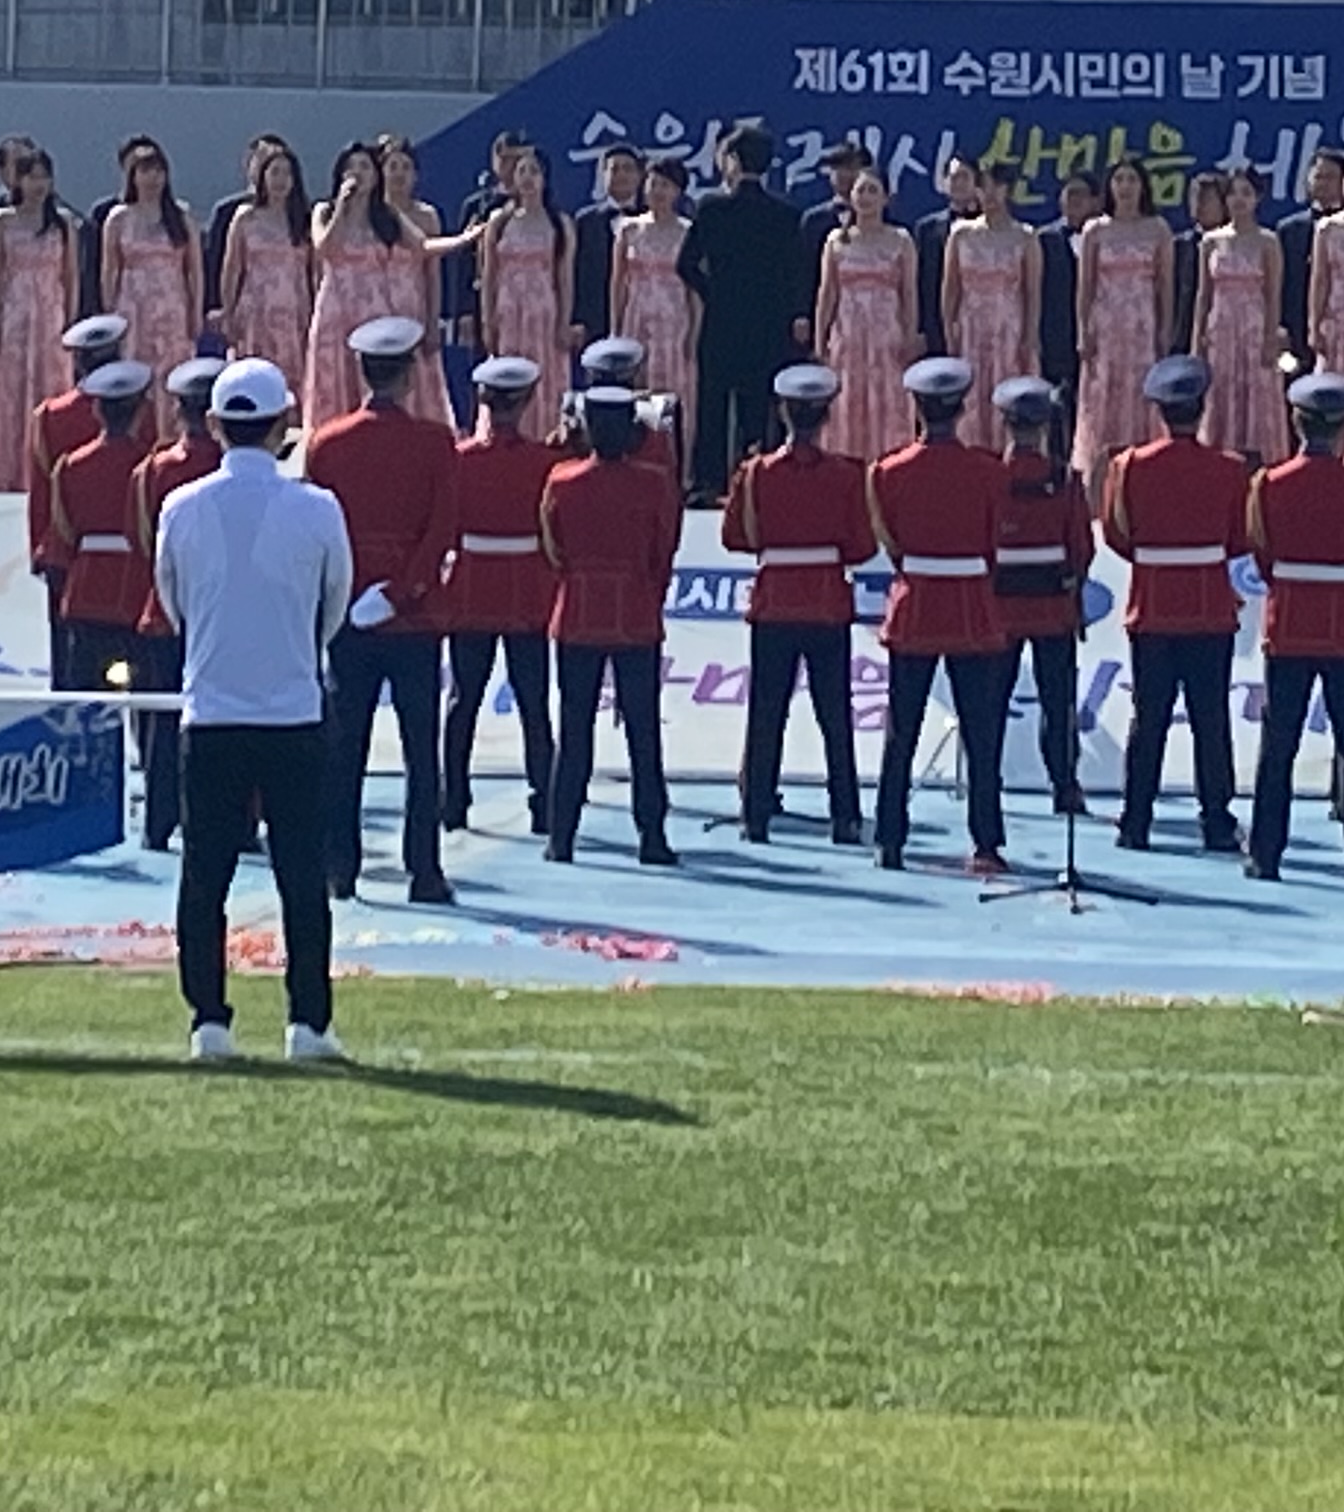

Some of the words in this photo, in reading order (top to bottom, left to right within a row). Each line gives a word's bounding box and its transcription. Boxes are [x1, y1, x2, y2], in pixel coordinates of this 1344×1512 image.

[793, 47, 930, 95] 제61회
[943, 50, 1165, 98] 수원시민의
[1179, 51, 1225, 99] 날
[1237, 54, 1327, 100] 기념
